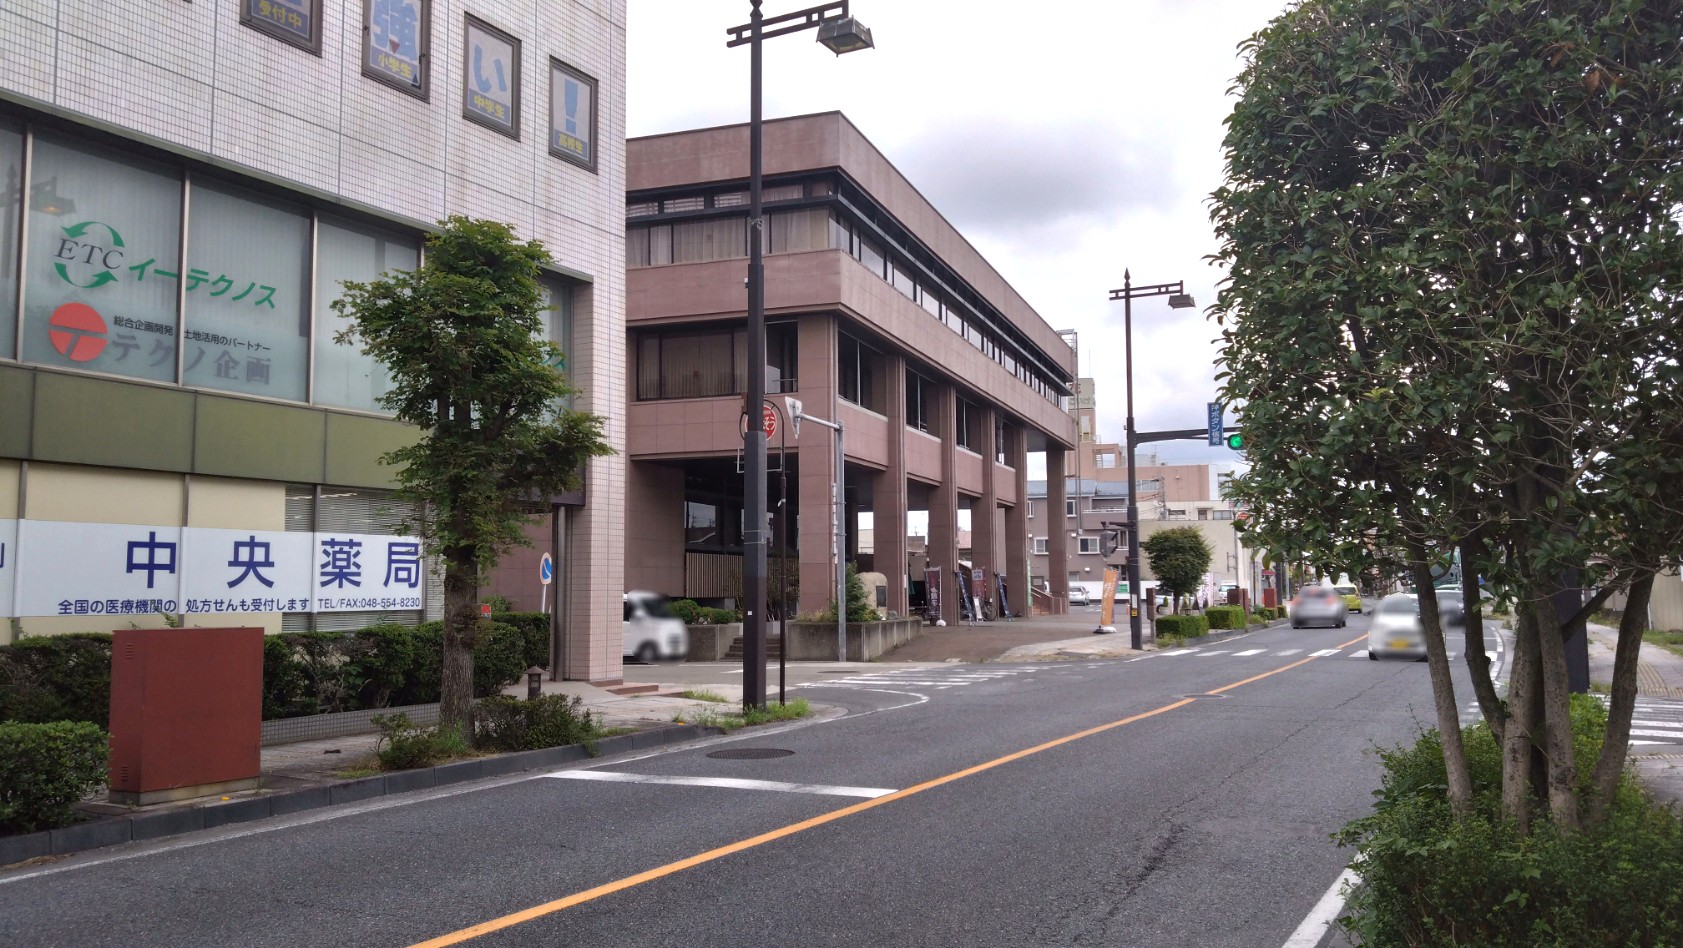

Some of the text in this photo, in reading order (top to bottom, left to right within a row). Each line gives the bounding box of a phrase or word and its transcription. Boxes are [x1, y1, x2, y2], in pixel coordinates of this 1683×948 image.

[258, 2, 302, 28] 受付中
[377, 53, 412, 79] 小学生
[473, 43, 507, 94] い
[473, 94, 505, 119] 中学生
[559, 133, 583, 153] 高校生
[54, 238, 124, 270] ETC
[128, 258, 277, 309] イーテクノス
[113, 315, 271, 351] 総合企画開発 土地活用のパートナー
[112, 333, 272, 385] テクノ企画
[126, 531, 420, 589] 中央薬局
[58, 598, 420, 615] 全国の医療機関の 処方せんも受付します TEL/FAX:048-554-8230
